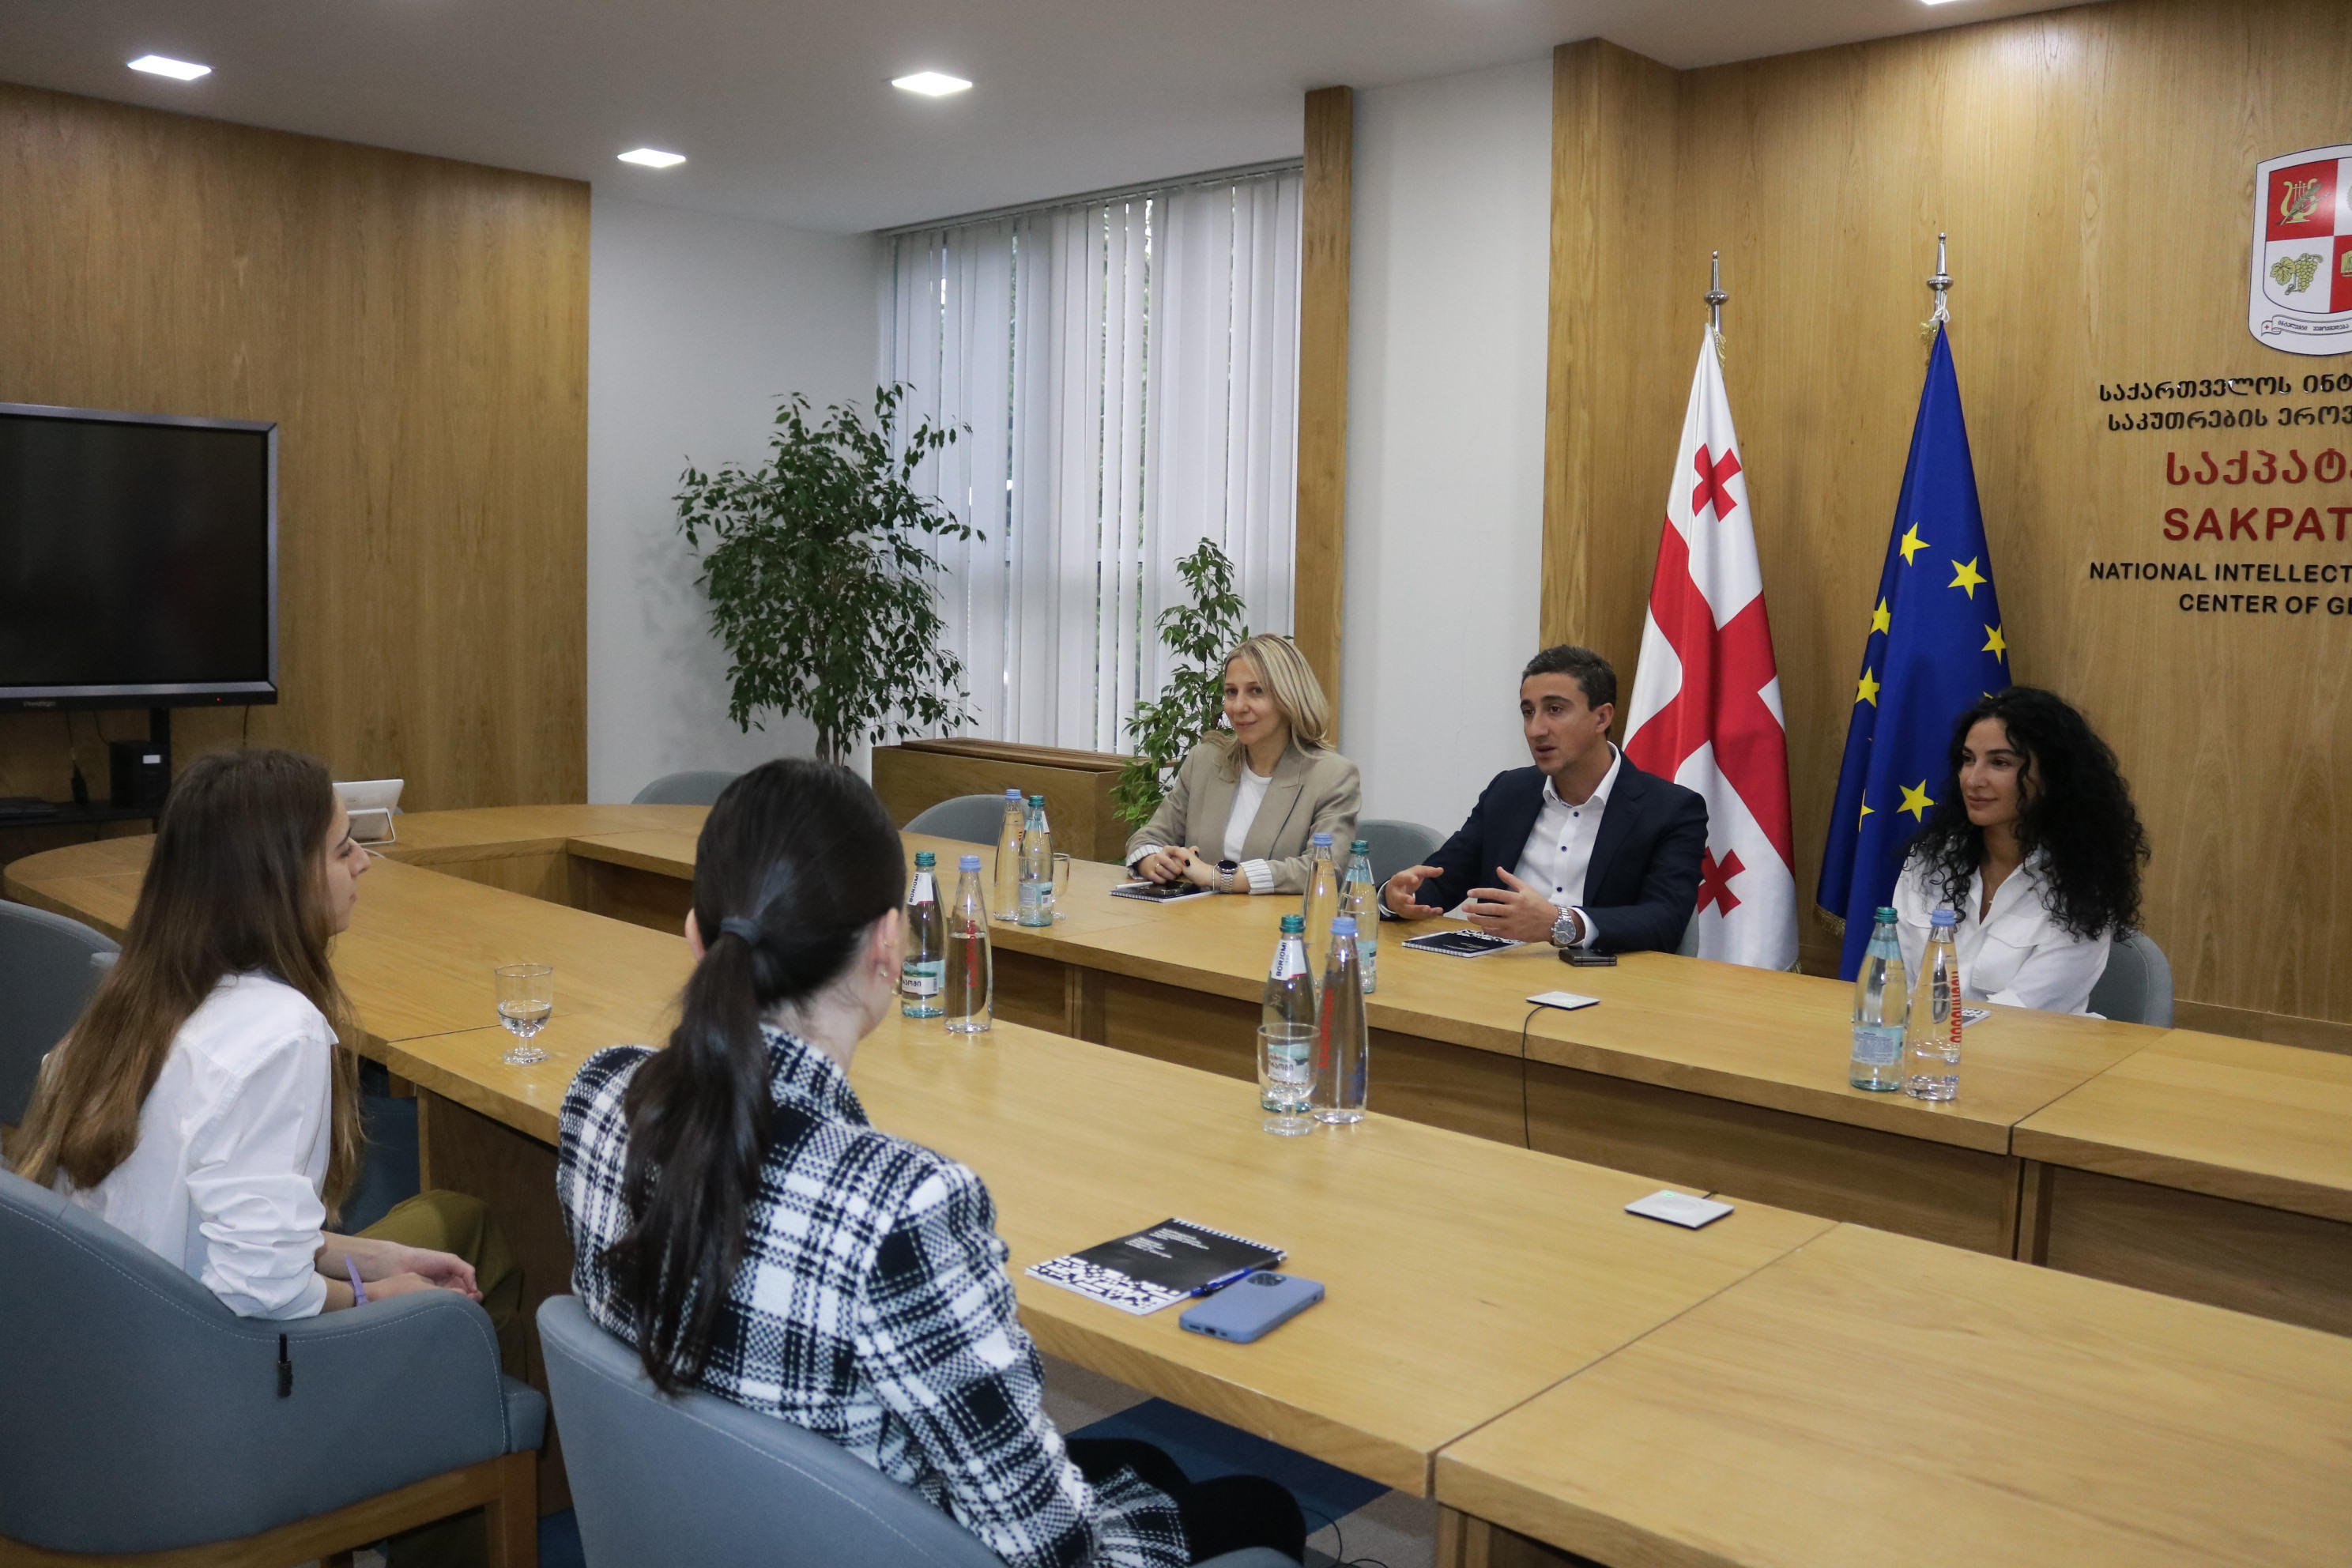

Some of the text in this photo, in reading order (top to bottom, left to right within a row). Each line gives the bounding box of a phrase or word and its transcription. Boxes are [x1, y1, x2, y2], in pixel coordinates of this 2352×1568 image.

[2099, 372, 2352, 401] საქართველოს ინტ
[2108, 405, 2352, 432] საკუთრების ეროვ
[2166, 447, 2352, 485] საქპატ
[2163, 507, 2352, 541] SAKPAT
[2090, 562, 2352, 583] NATIONAL INTELLECT
[2178, 594, 2278, 613] CENTER
[2285, 595, 2320, 614] OF
[1276, 942, 1287, 977] BORJOMI
